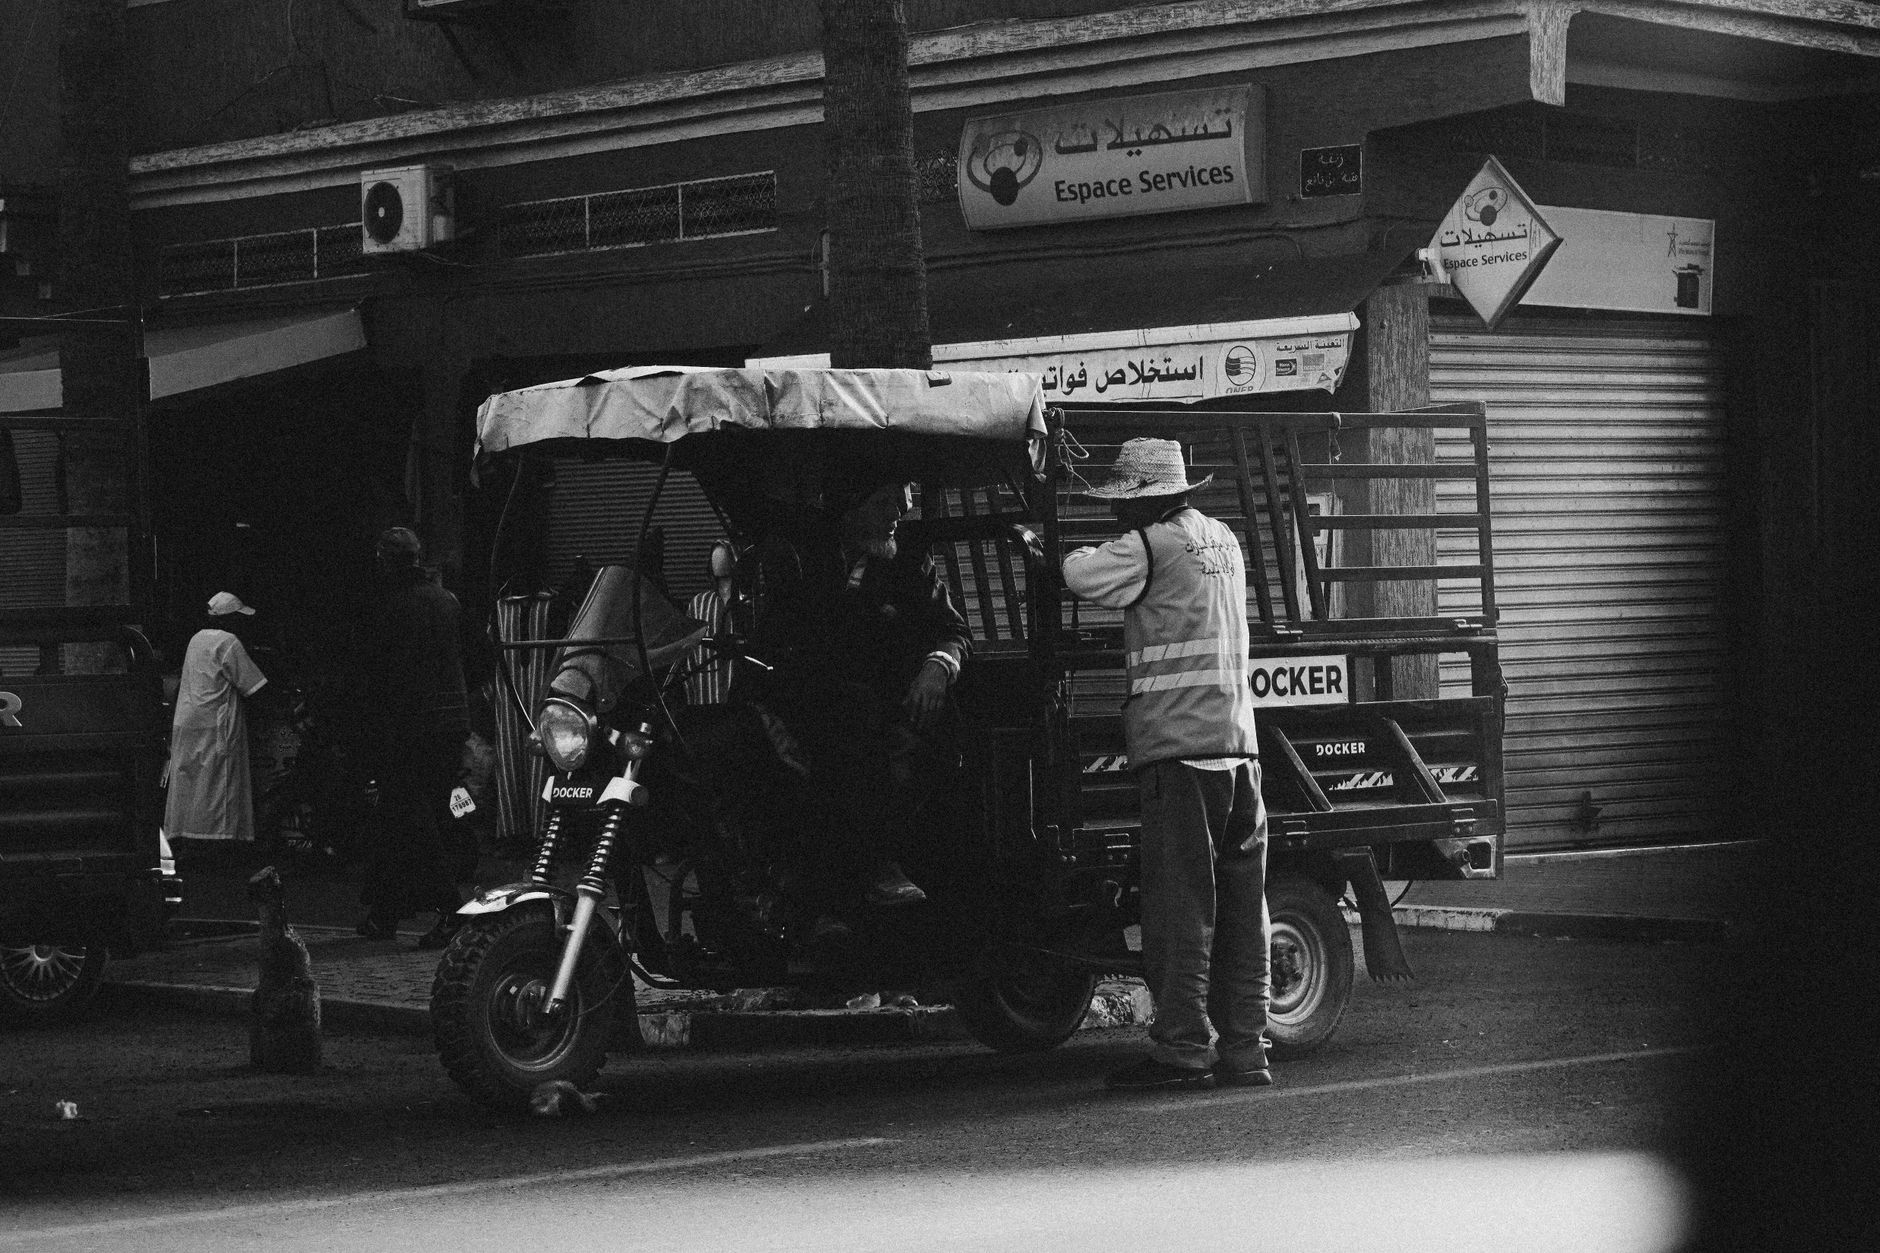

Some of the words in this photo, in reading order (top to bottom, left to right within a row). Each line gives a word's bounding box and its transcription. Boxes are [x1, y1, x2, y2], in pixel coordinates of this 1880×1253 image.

[1054, 107, 1232, 158] تسهيلات
[1054, 175, 1132, 204] Espace
[1139, 164, 1235, 194] Services
[1440, 223, 1528, 248] تسهيلات
[1443, 257, 1478, 271] Espace
[1481, 251, 1528, 266] Services
[1276, 341, 1313, 354] السريعة
[1095, 355, 1204, 396] استخلاص
[1248, 665, 1343, 699] OCKER
[1315, 741, 1366, 757] DOCKER
[552, 786, 593, 800] DOCKER
